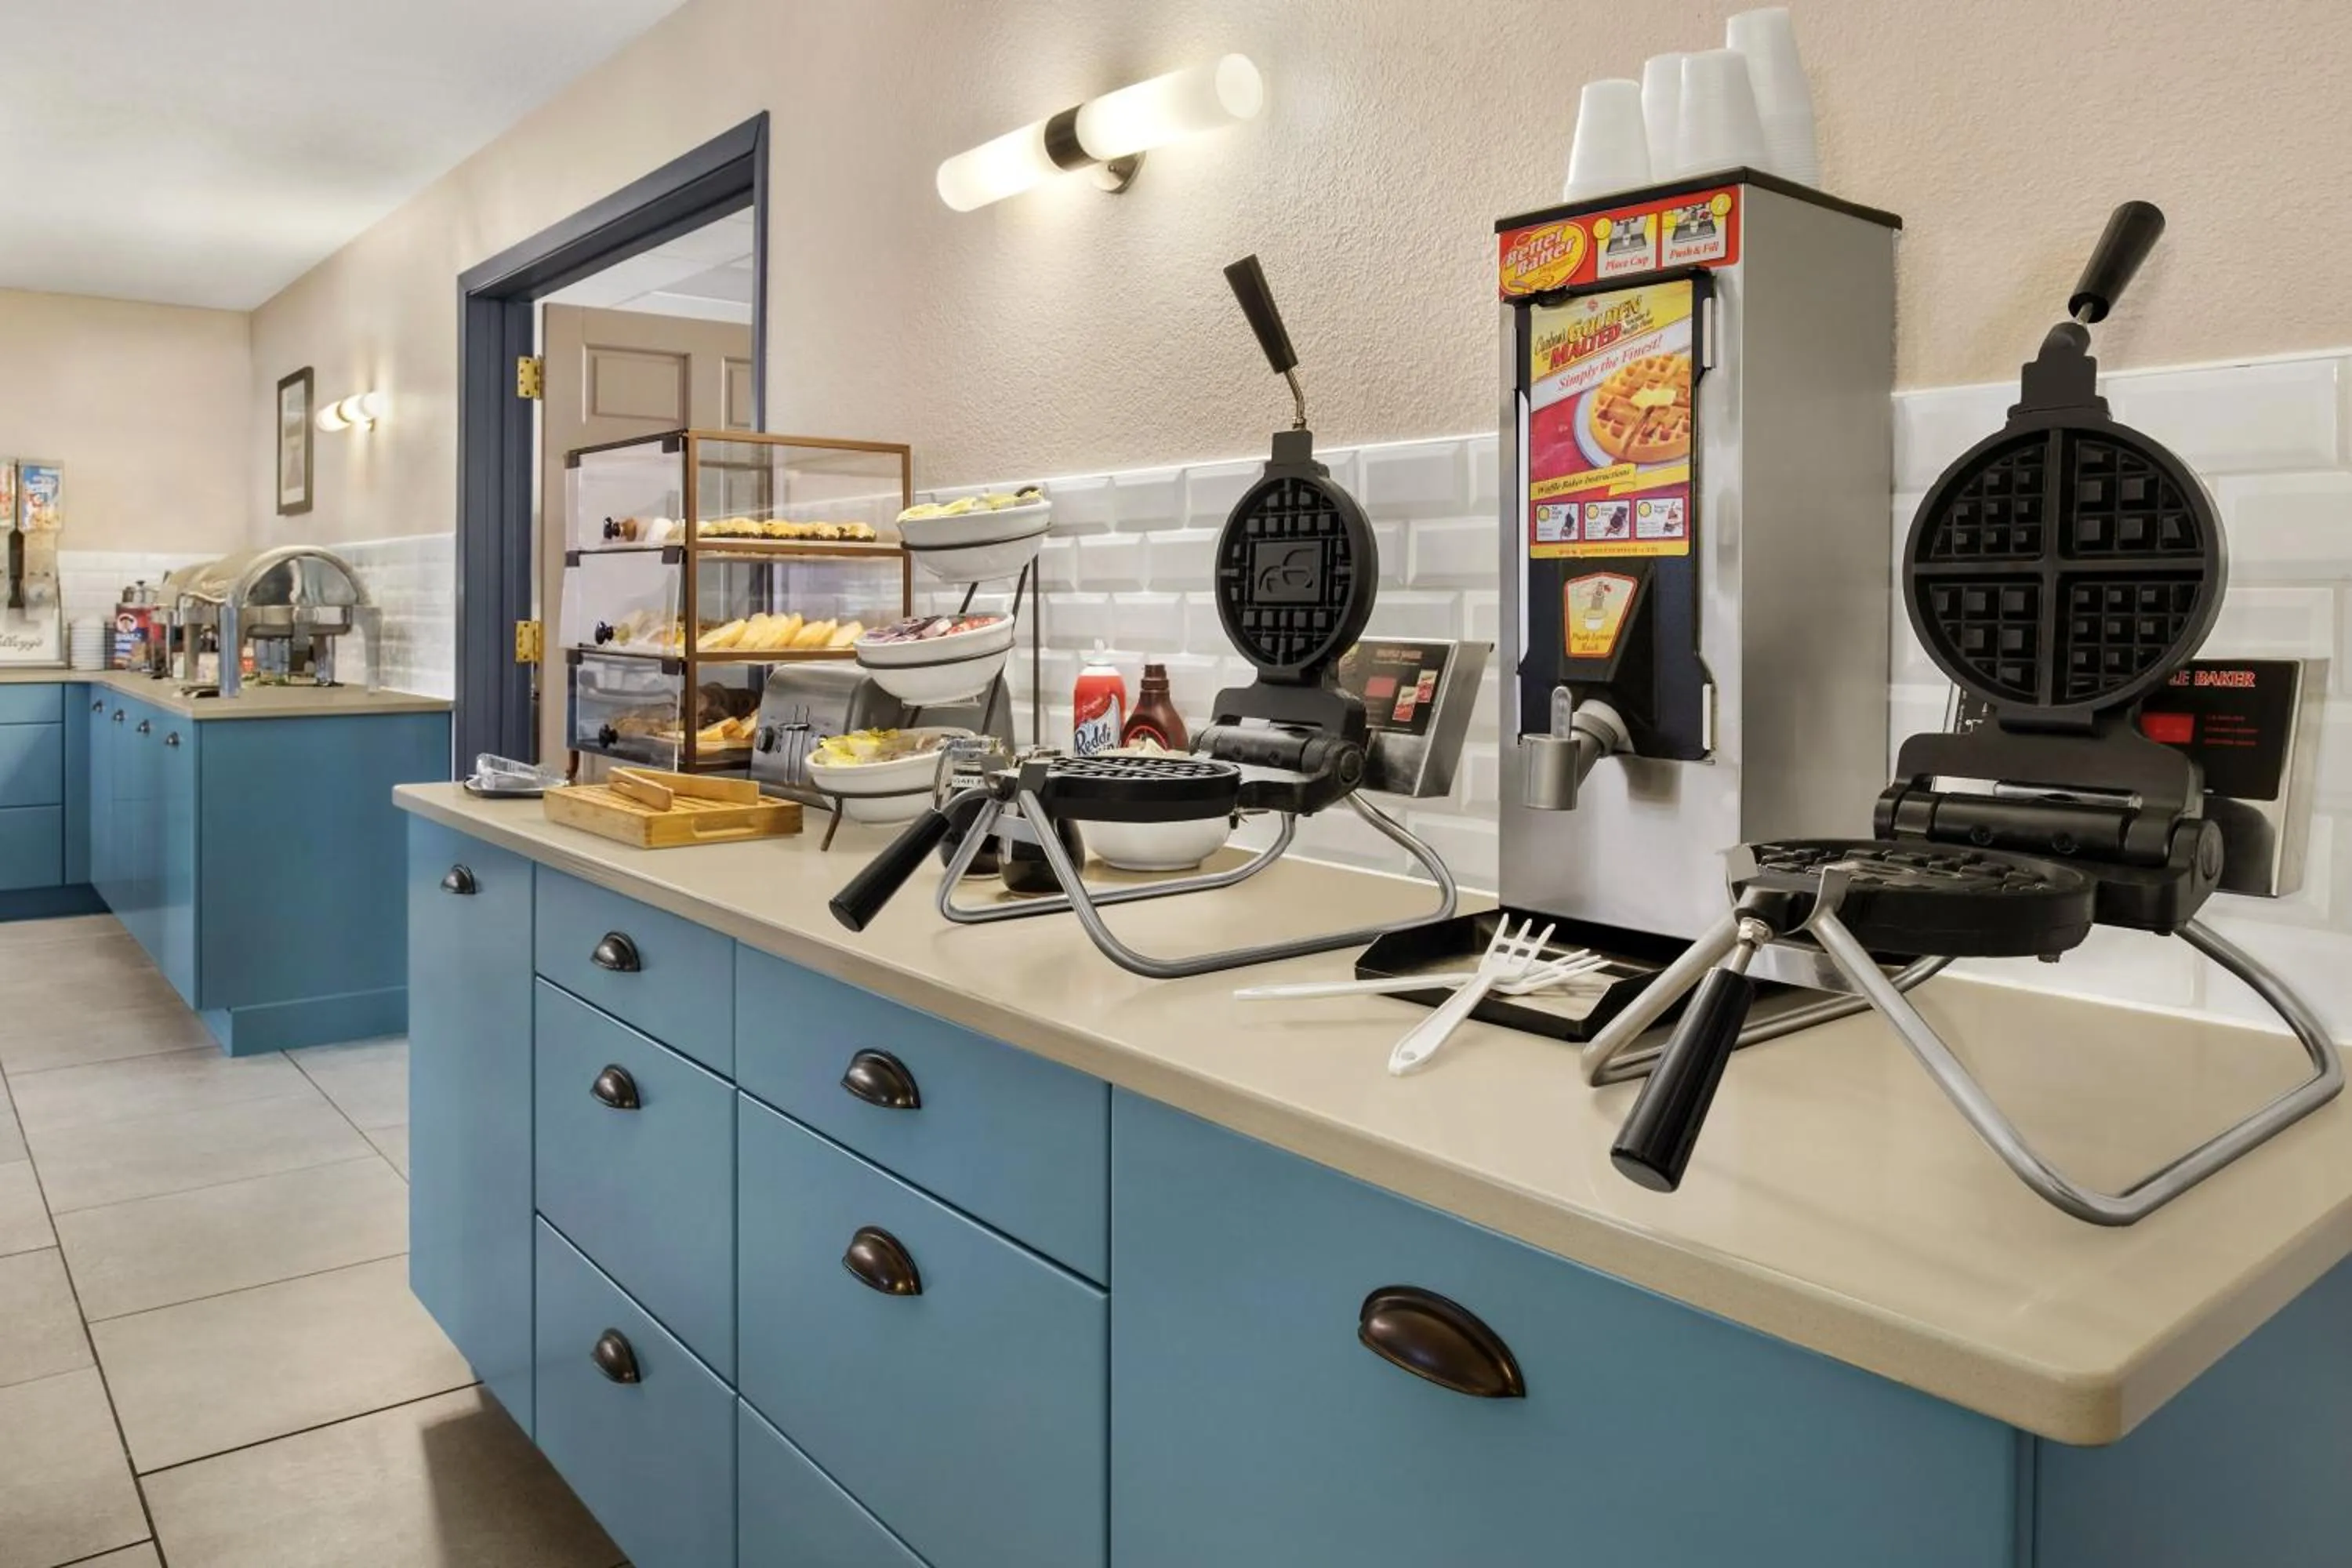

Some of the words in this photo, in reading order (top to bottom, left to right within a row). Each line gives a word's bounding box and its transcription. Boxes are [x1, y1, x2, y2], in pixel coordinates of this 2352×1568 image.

[1506, 225, 1564, 267] Better
[1515, 238, 1575, 277] Batter
[1669, 246, 1692, 260] Push
[1702, 241, 1719, 253] Fill
[1606, 259, 1628, 270] Place
[1630, 256, 1649, 267] Cup
[1550, 321, 1622, 369] MALTED
[1558, 365, 1599, 390] Simply
[1600, 356, 1620, 372] the
[1622, 334, 1663, 363] Finest!
[1537, 481, 1561, 495] Waffle
[2194, 670, 2256, 688] BAKER
[1074, 723, 1111, 755] Reddi
